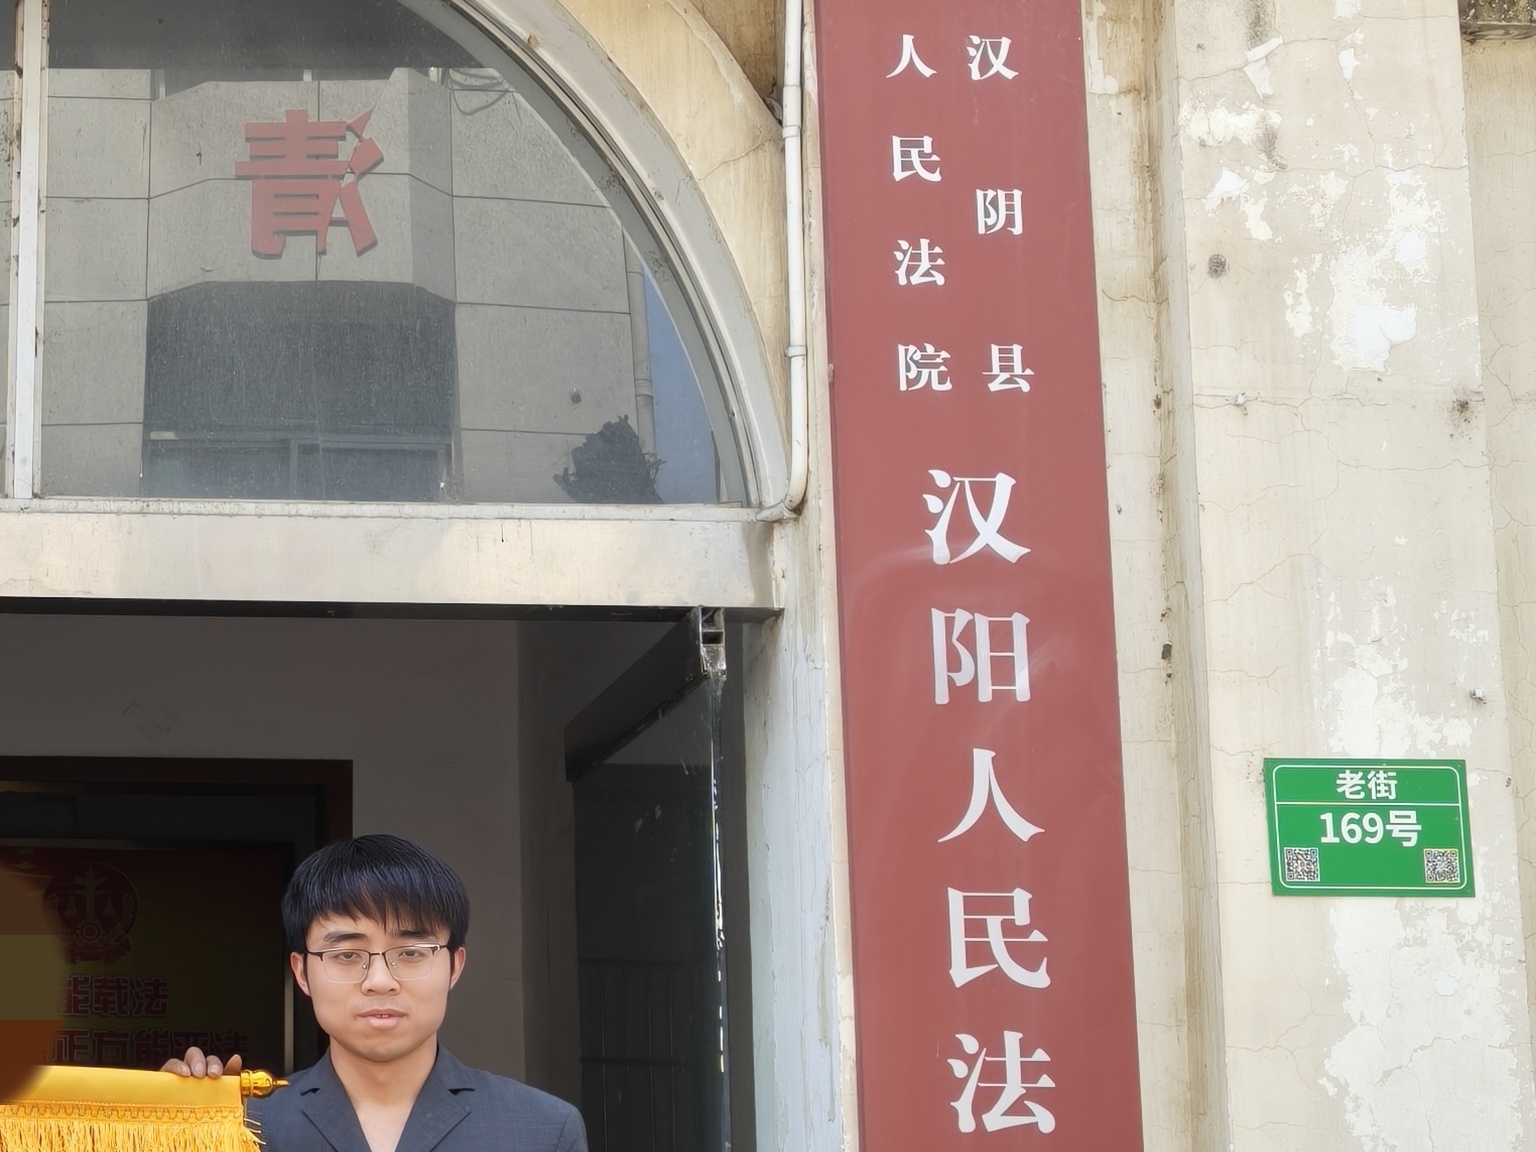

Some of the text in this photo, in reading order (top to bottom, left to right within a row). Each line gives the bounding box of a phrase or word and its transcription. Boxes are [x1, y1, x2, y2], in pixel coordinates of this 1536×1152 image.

[885, 33, 953, 392] 人民法院
[966, 34, 1035, 393] 汉阴县
[1319, 809, 1422, 848] 169号
[1336, 769, 1398, 800] 老街
